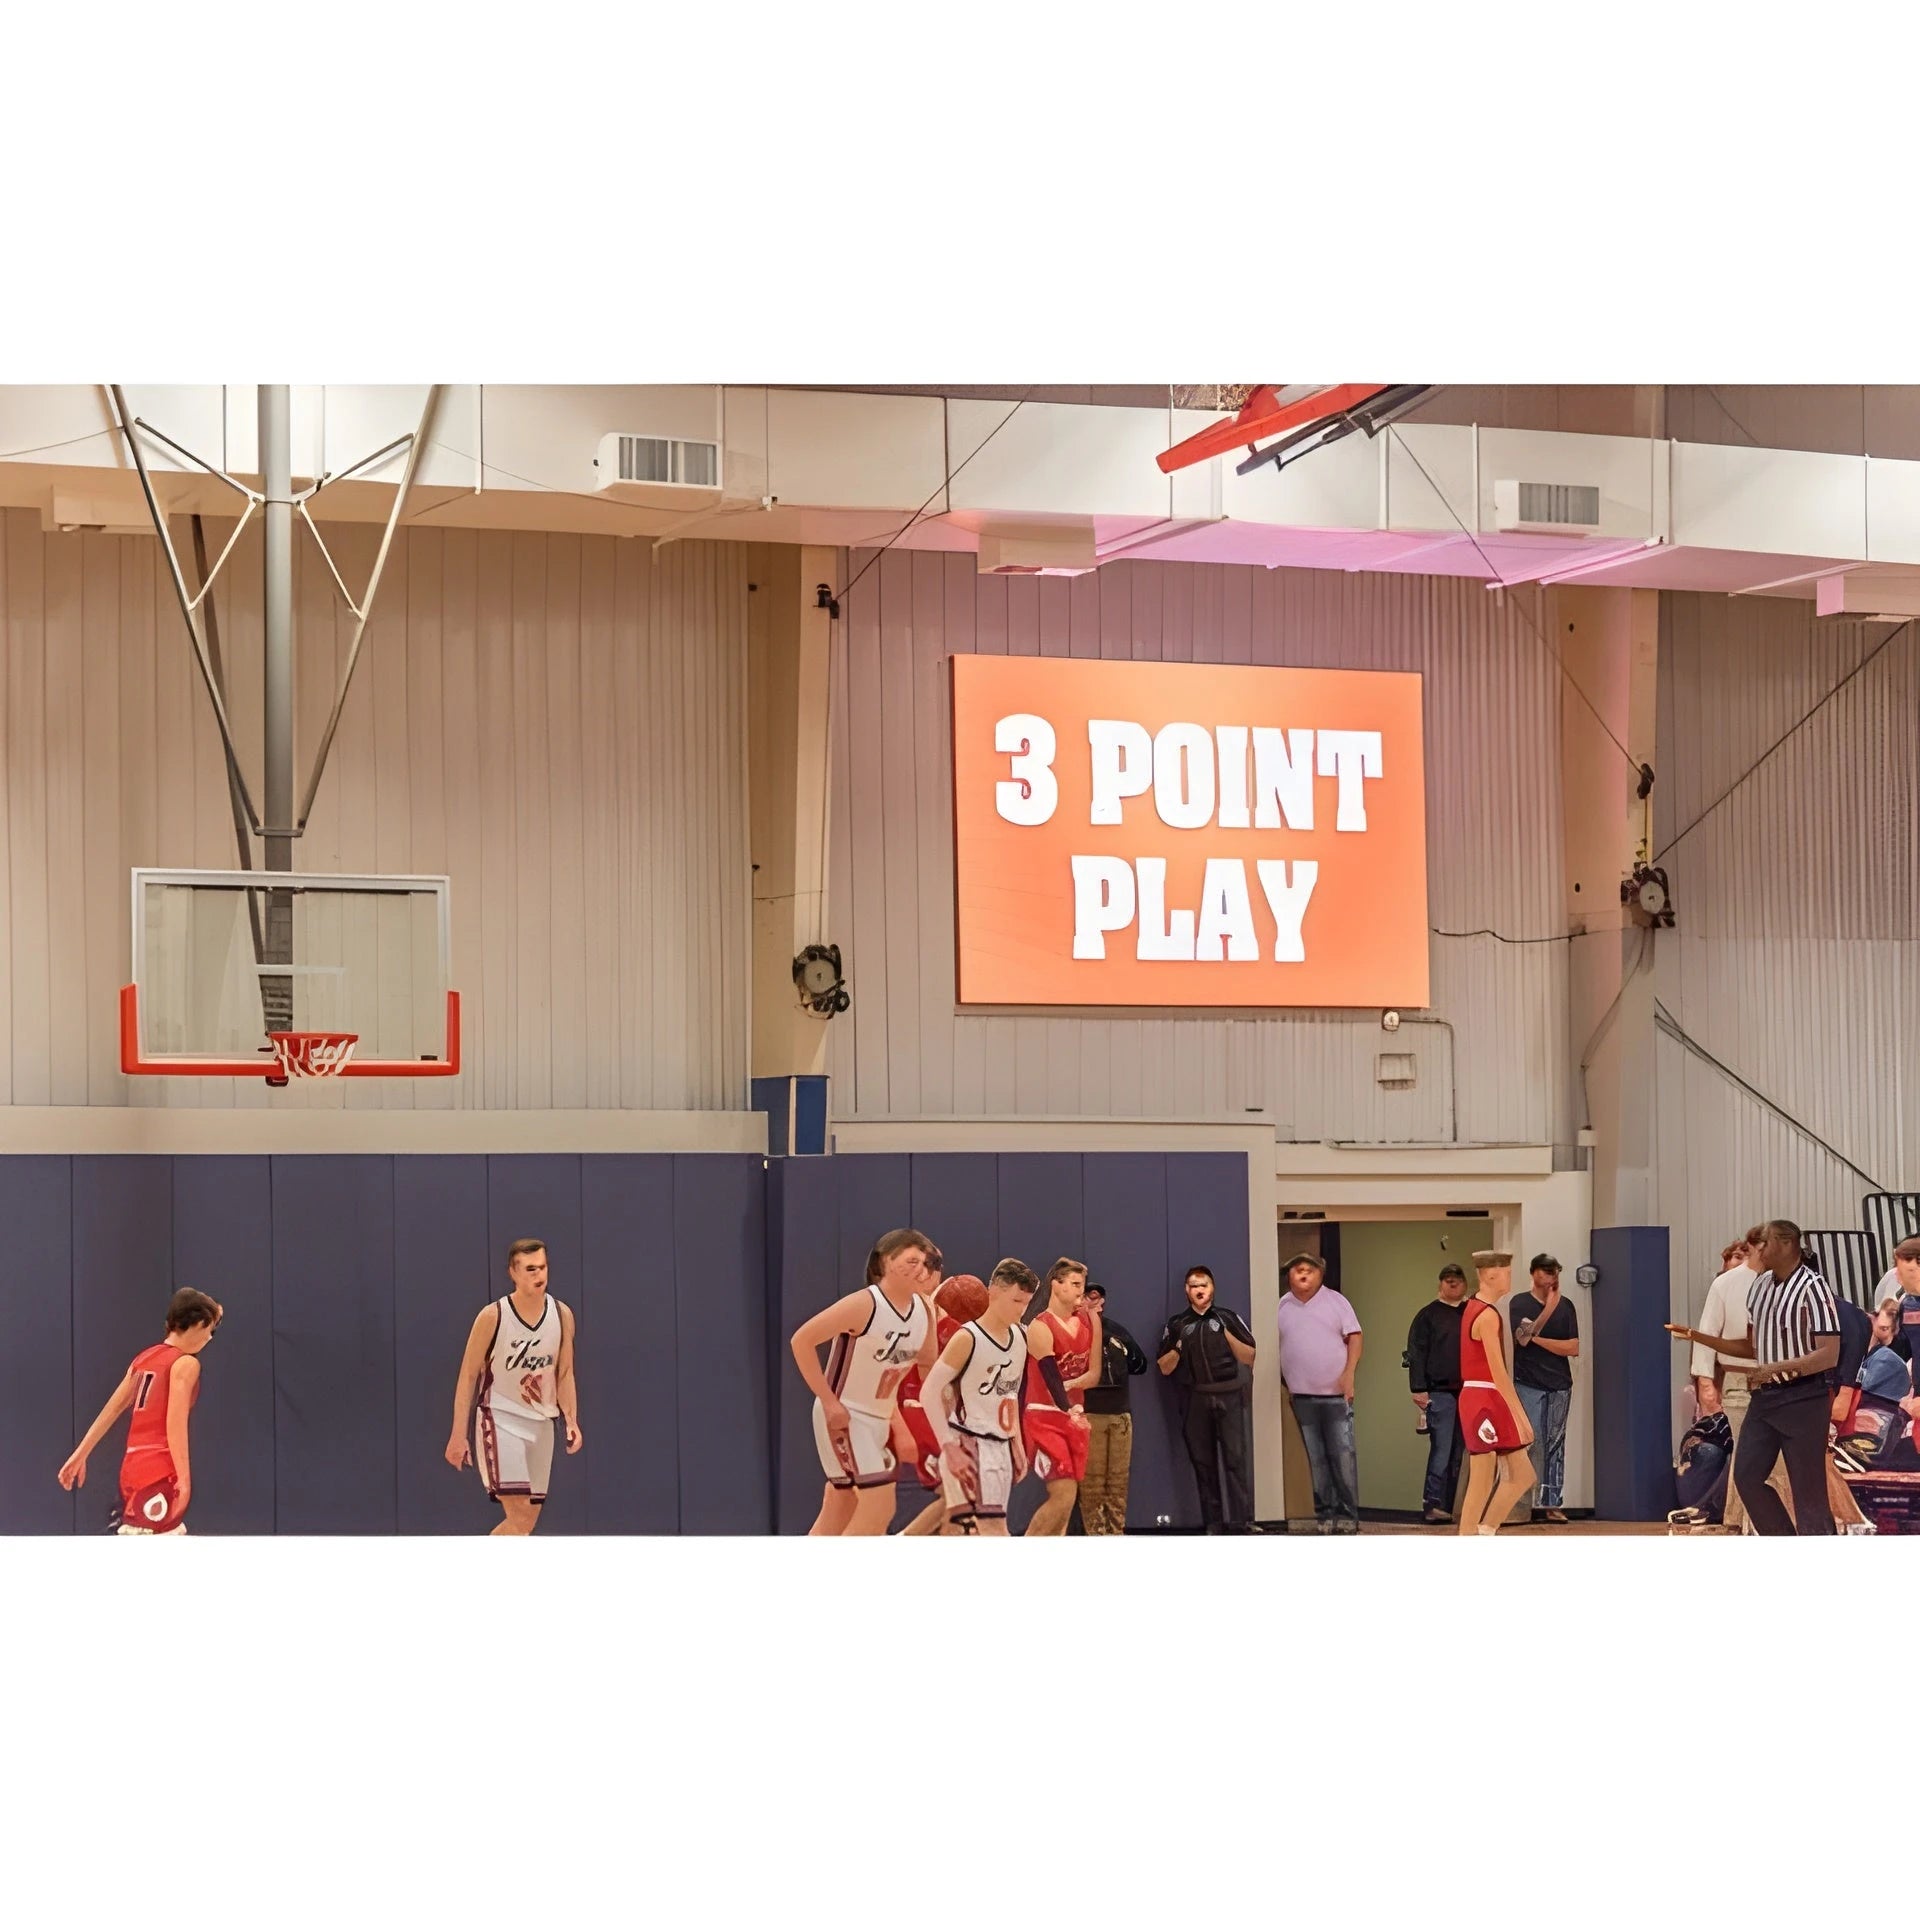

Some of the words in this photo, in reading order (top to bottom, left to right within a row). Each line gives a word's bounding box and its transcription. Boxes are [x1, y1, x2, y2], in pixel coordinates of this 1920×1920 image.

[995, 713, 1058, 826] 3
[1088, 719, 1383, 832] POINT
[1071, 855, 1319, 961] PLAY
